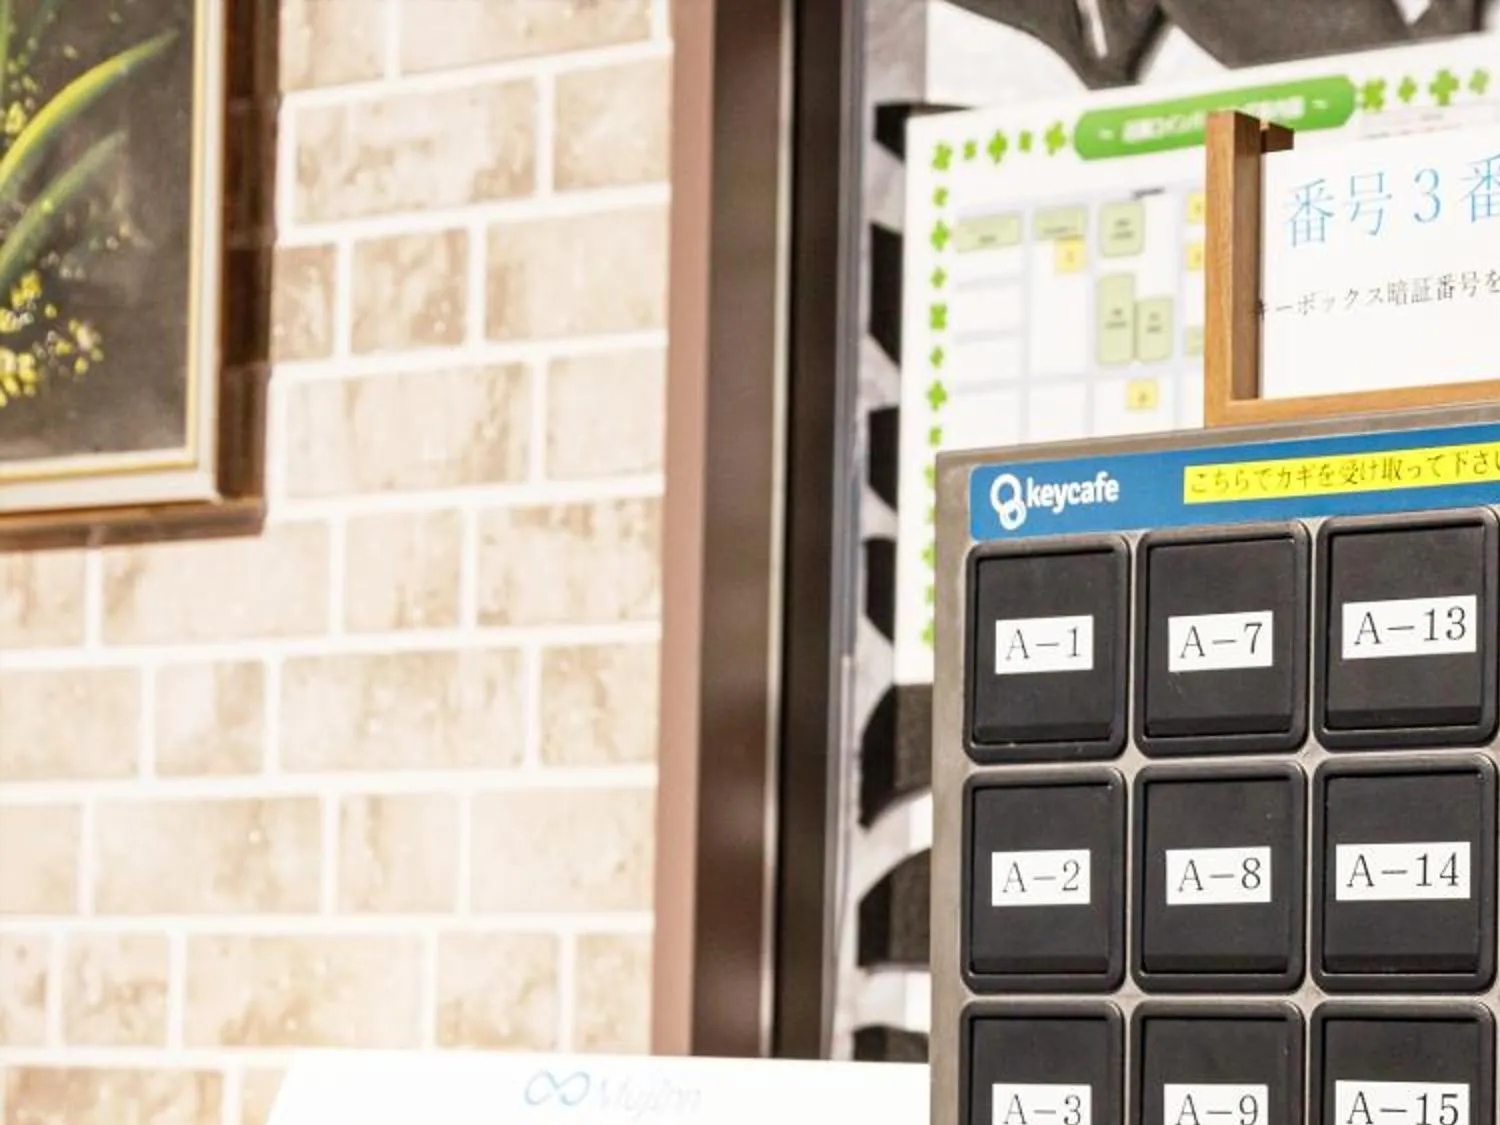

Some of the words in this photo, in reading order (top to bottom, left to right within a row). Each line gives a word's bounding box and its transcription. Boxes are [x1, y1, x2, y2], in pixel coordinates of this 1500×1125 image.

[1026, 470, 1120, 515] keycafe
[1181, 622, 1263, 658] A-7
[1354, 607, 1466, 645] A-13
[1005, 628, 1077, 661] A-1
[1004, 863, 1079, 893] A-2
[1179, 858, 1261, 891] A-8
[1347, 853, 1458, 888] A-14
[1004, 1094, 1081, 1125] A-3
